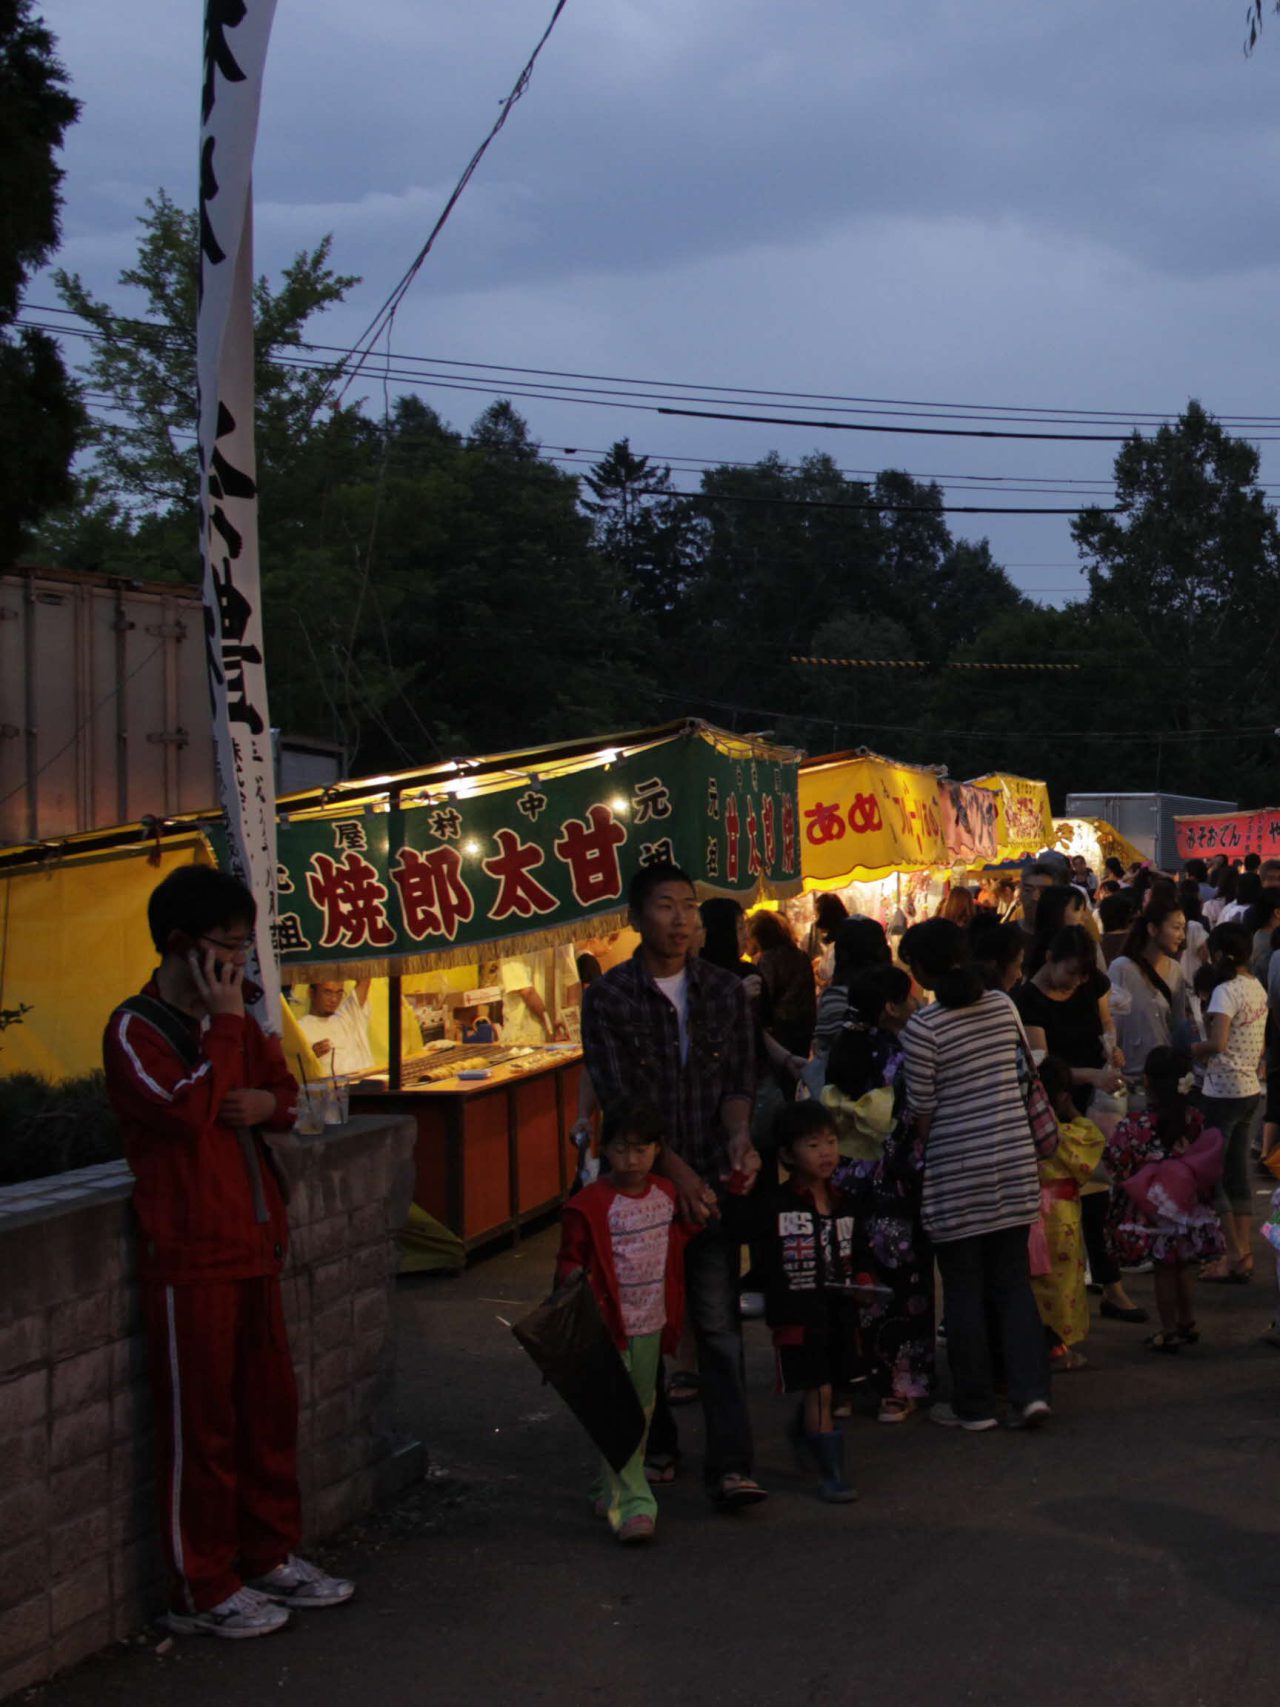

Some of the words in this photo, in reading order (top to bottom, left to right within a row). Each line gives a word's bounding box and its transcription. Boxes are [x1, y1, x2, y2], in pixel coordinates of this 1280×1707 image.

[804, 793, 883, 845] あめ
[1186, 824, 1241, 849] みそおでん
